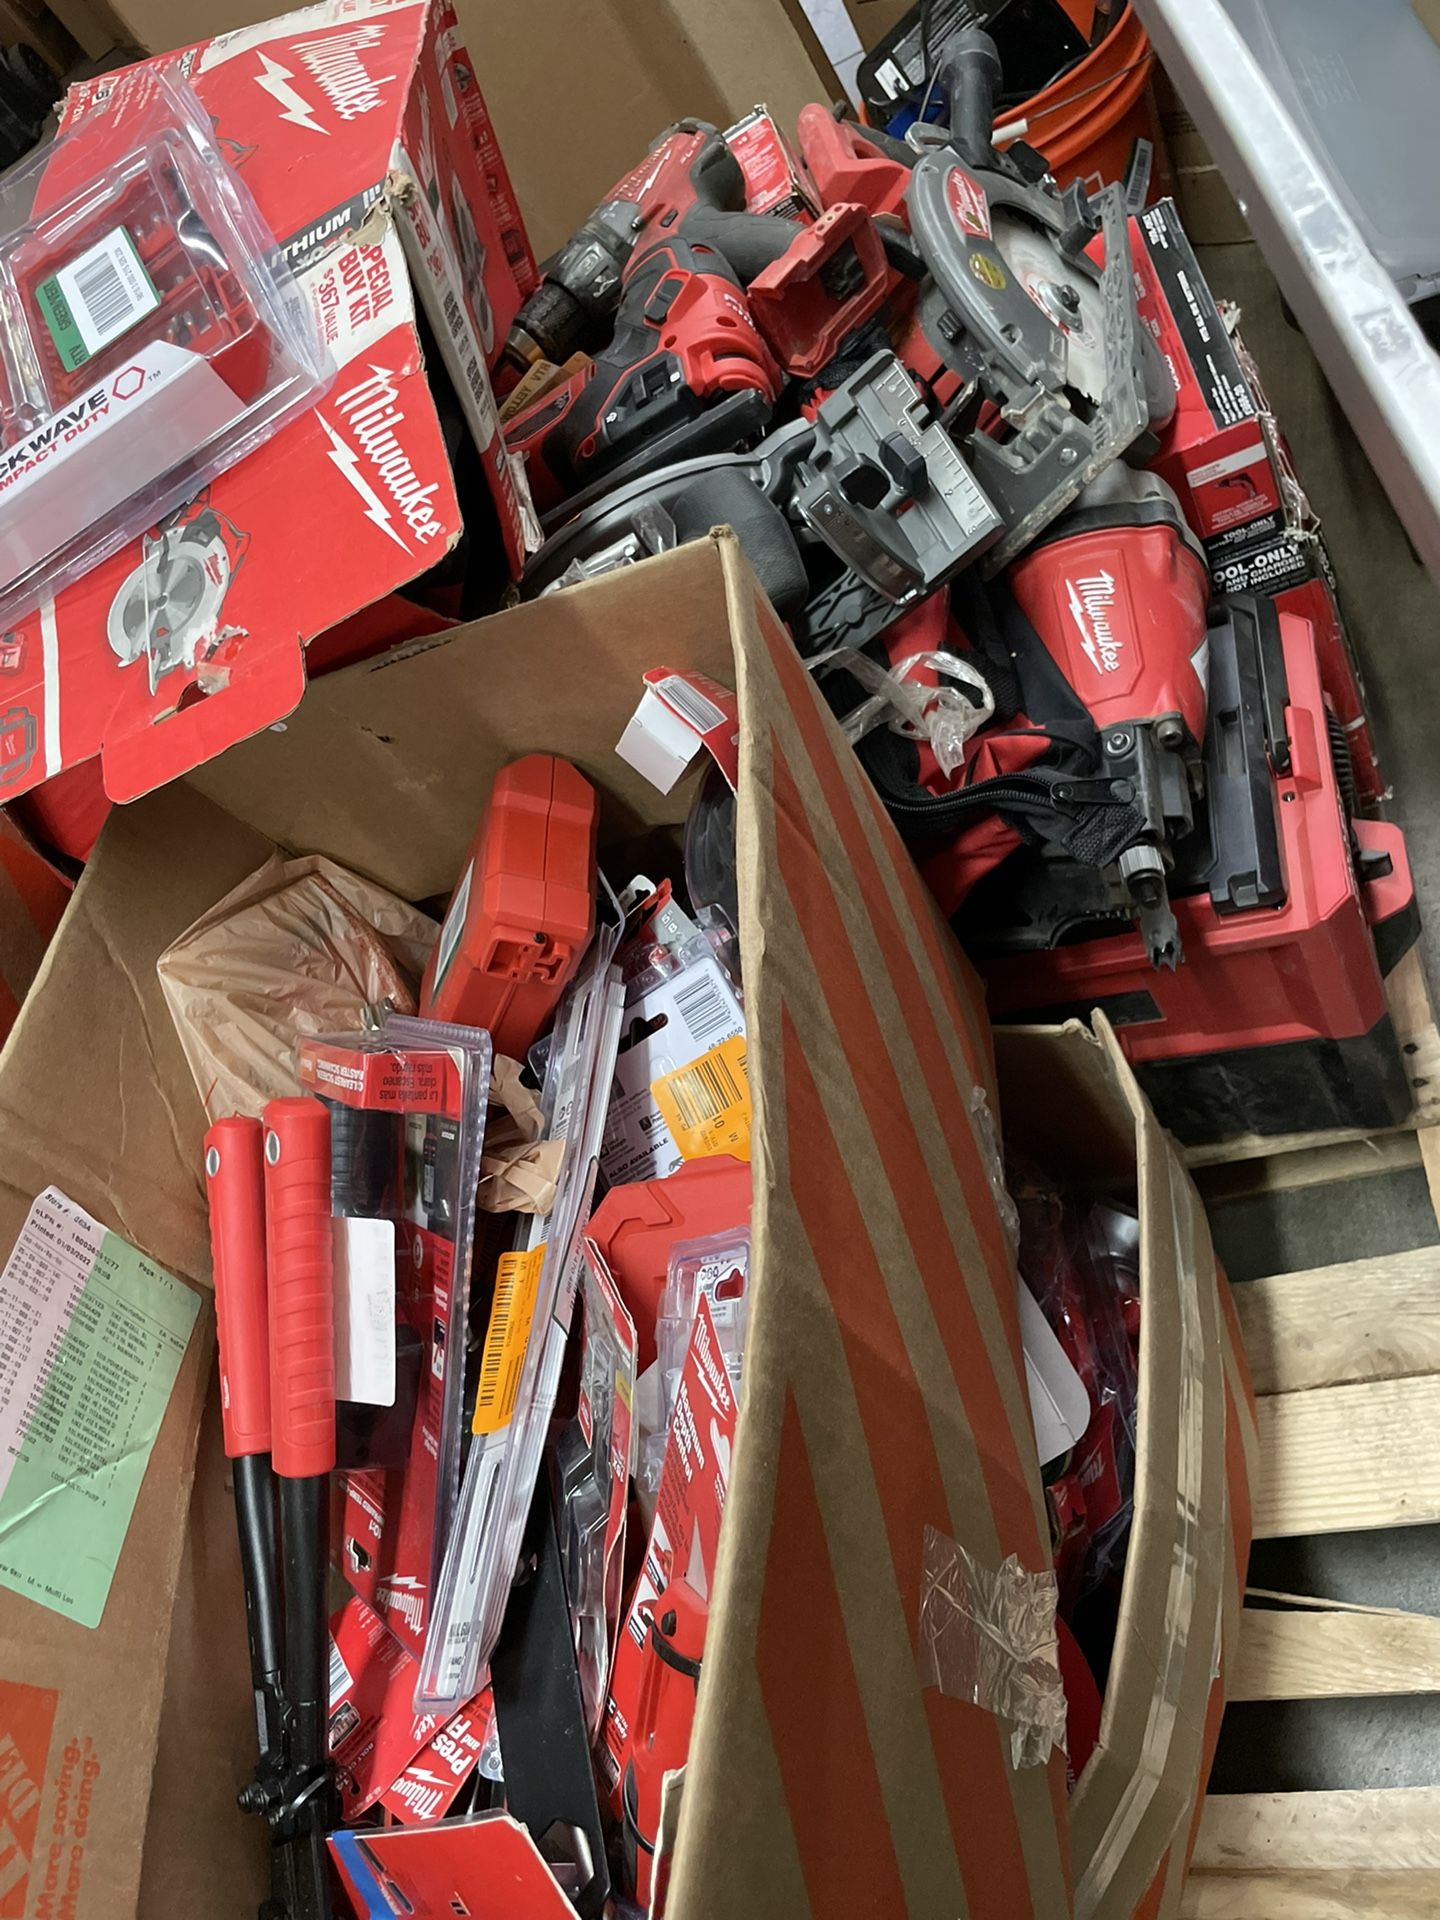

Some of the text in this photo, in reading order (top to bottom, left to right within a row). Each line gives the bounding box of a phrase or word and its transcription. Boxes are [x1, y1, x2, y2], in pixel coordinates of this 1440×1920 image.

[289, 24, 398, 121] Milwaukee
[265, 207, 351, 269] ITHIUM
[316, 267, 341, 344] $367 VALUE
[337, 248, 371, 329] BUY KIT
[68, 343, 87, 365] RTV
[64, 403, 110, 443] DUTY
[334, 364, 441, 546] Milwaukee
[1223, 515, 1275, 540] TOOL-ONLY
[1213, 543, 1300, 583] OOL-ONLY
[1225, 573, 1249, 588] AND
[1250, 554, 1304, 578] CHARGER
[1225, 581, 1249, 594] NOT
[1249, 559, 1306, 586] INCLUDED
[1075, 568, 1120, 673] Milwaukee
[608, 1137, 668, 1178] ALSO AVAILABLE
[29, 1218, 56, 1241] Printed:
[694, 1313, 732, 1412] Milwaukee
[675, 1398, 693, 1452] Depth
[678, 1380, 706, 1468] Maximum
[672, 1416, 693, 1482] Control
[376, 1587, 424, 1636] Milwaukee
[431, 1732, 474, 1776] Pres
[460, 1731, 481, 1750] and
[391, 1777, 444, 1820] Milwa
